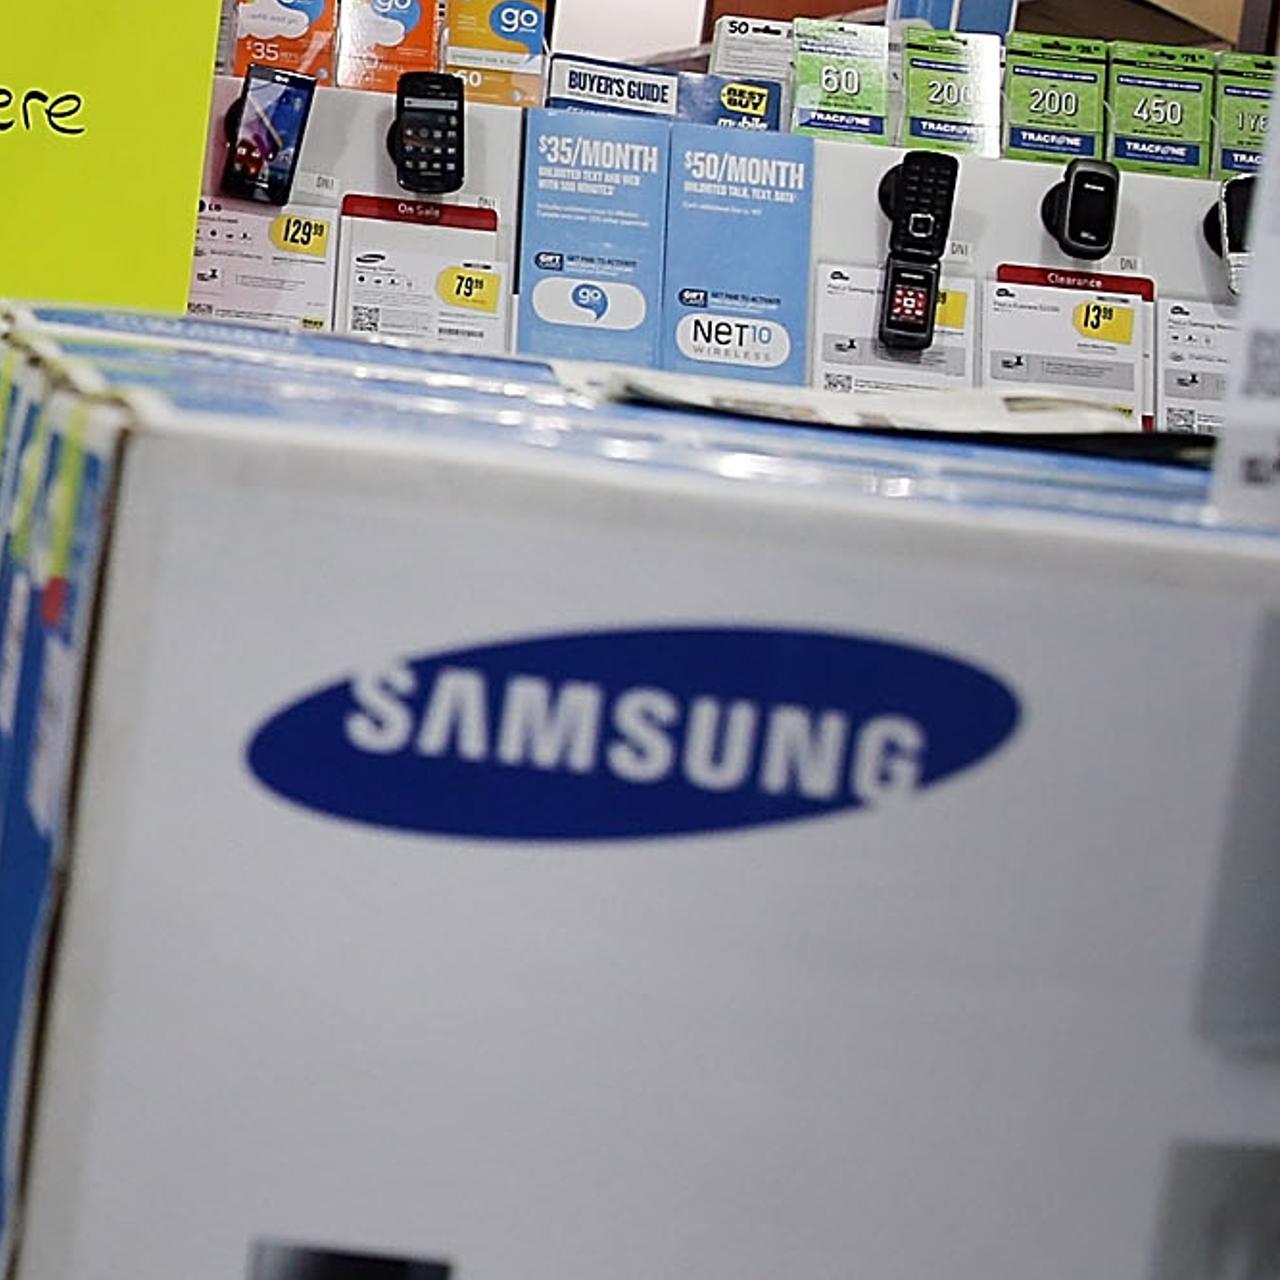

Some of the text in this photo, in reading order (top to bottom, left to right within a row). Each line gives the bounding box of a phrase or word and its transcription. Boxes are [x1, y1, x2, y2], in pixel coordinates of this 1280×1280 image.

[500, 6, 539, 33] go
[245, 40, 280, 62] $35
[568, 69, 670, 104] BUYER'S GUIDE
[821, 66, 860, 95] 60
[726, 86, 766, 102] BEST
[1029, 87, 1078, 116] 200
[727, 96, 761, 111] BUY
[1133, 97, 1183, 125] 450
[810, 110, 871, 127] TRACFONE
[920, 120, 980, 135] TRACFON
[1020, 131, 1082, 147] TRACFONE
[538, 134, 659, 174] $35/MONTH
[1125, 141, 1188, 157] TRACFONE
[1232, 153, 1263, 164] TRAC
[683, 150, 806, 190] $50/MONTH
[397, 202, 414, 215] On
[1046, 272, 1104, 289] Clearance
[578, 288, 601, 305] go
[692, 345, 773, 362] WIRELESS
[343, 656, 930, 811] SAMSUNG
